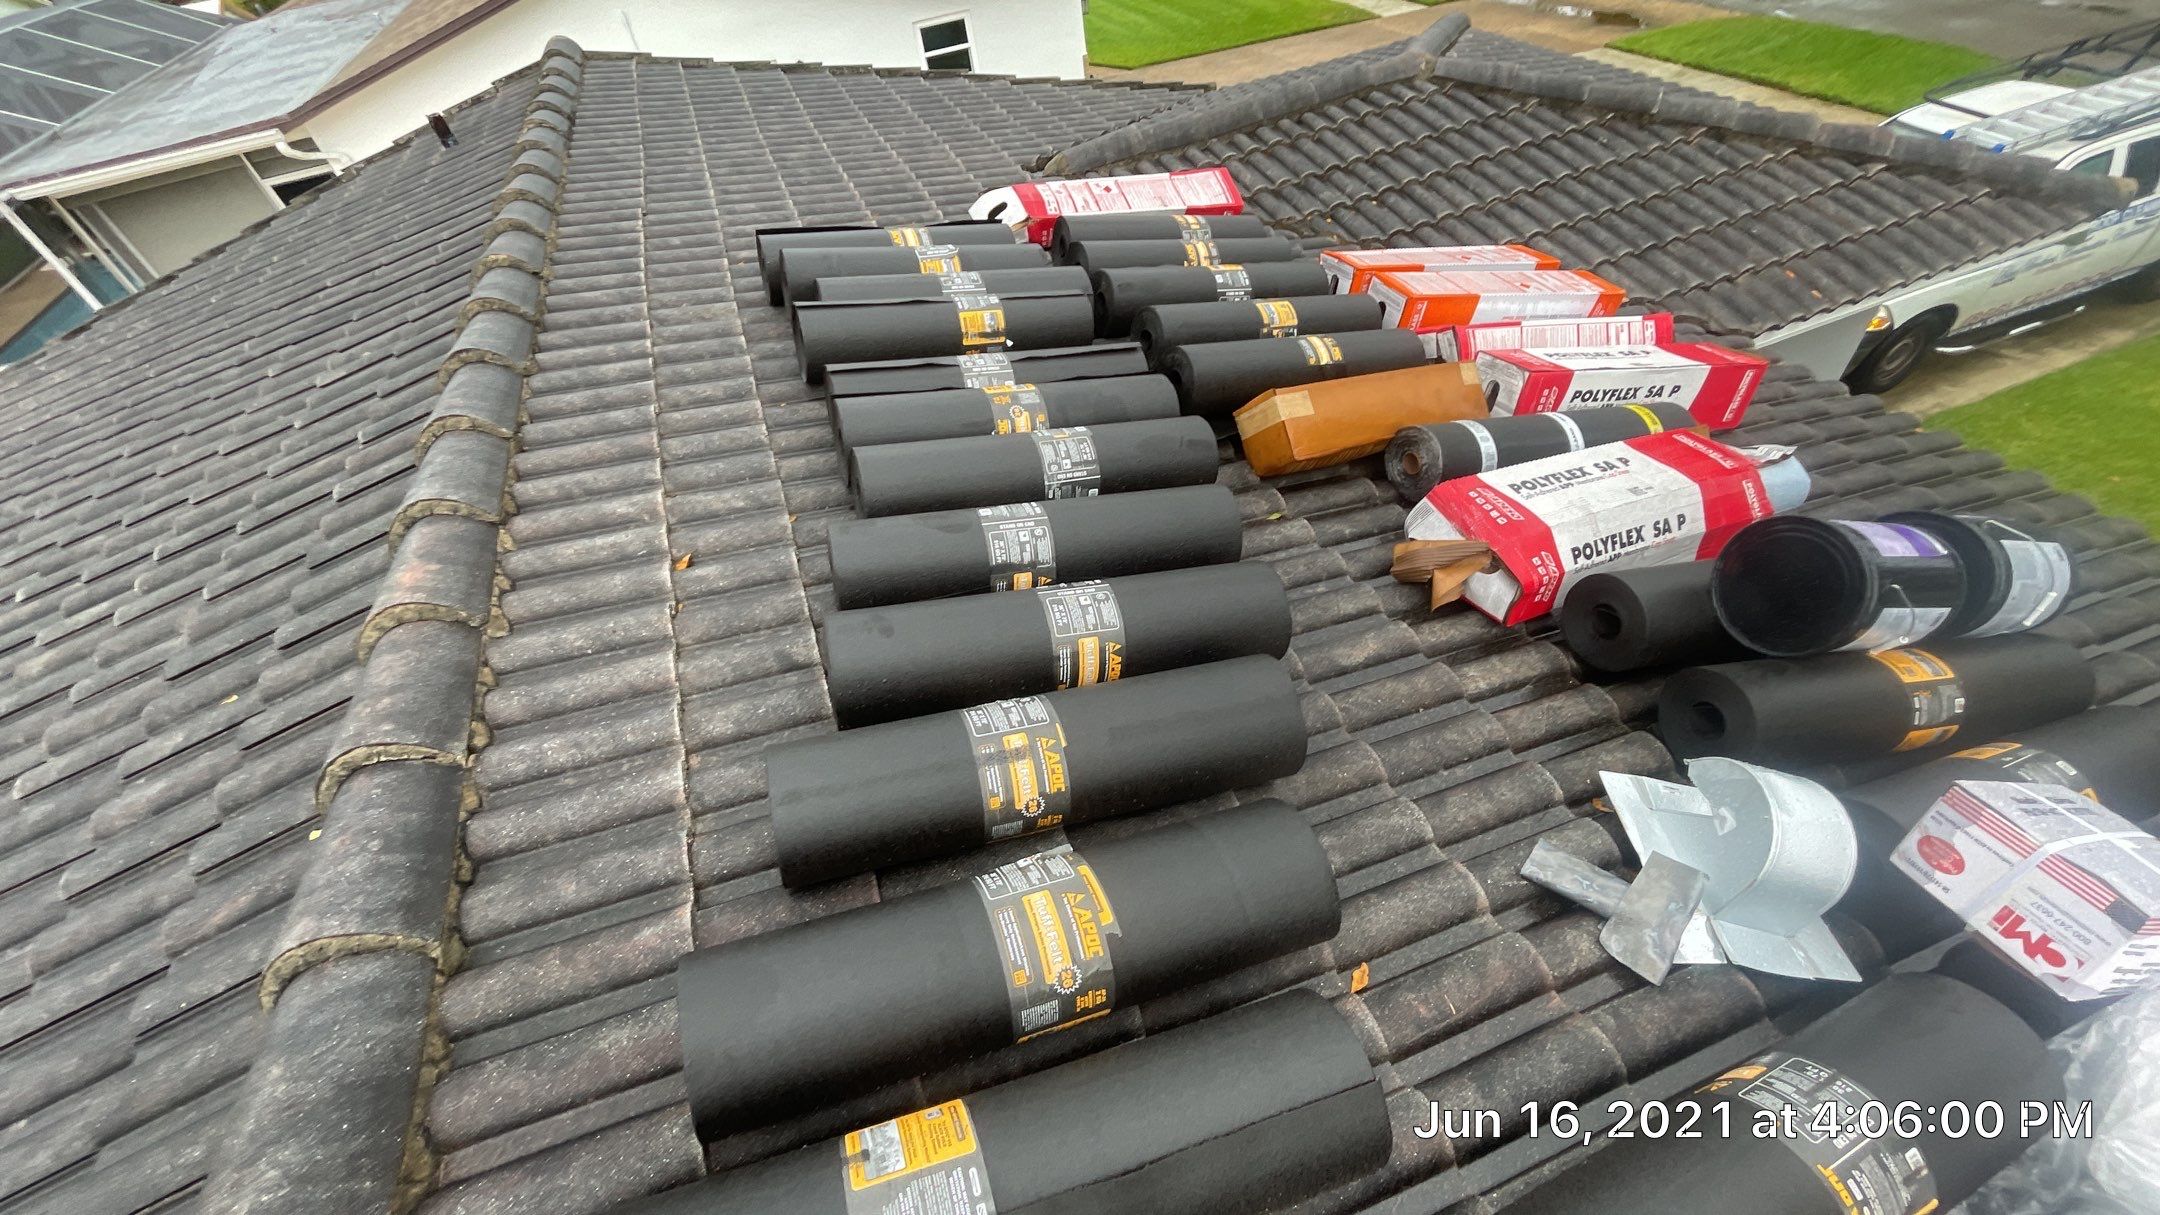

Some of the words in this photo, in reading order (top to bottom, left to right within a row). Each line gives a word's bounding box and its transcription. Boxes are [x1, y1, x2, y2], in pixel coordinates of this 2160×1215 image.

[1570, 387, 1642, 402] POLYFLEX
[1644, 386, 1663, 398] SA
[1668, 385, 1681, 397] P
[1507, 467, 1588, 495] POLYFLEX
[1596, 460, 1619, 474] SA
[1619, 457, 1632, 467] P
[1571, 525, 1645, 565] POLYFLEX
[1653, 518, 1672, 539] SA
[1677, 514, 1687, 532] P
[1608, 553, 1622, 564] APP
[1043, 751, 1066, 794] APOC
[1072, 908, 1105, 960] APOC
